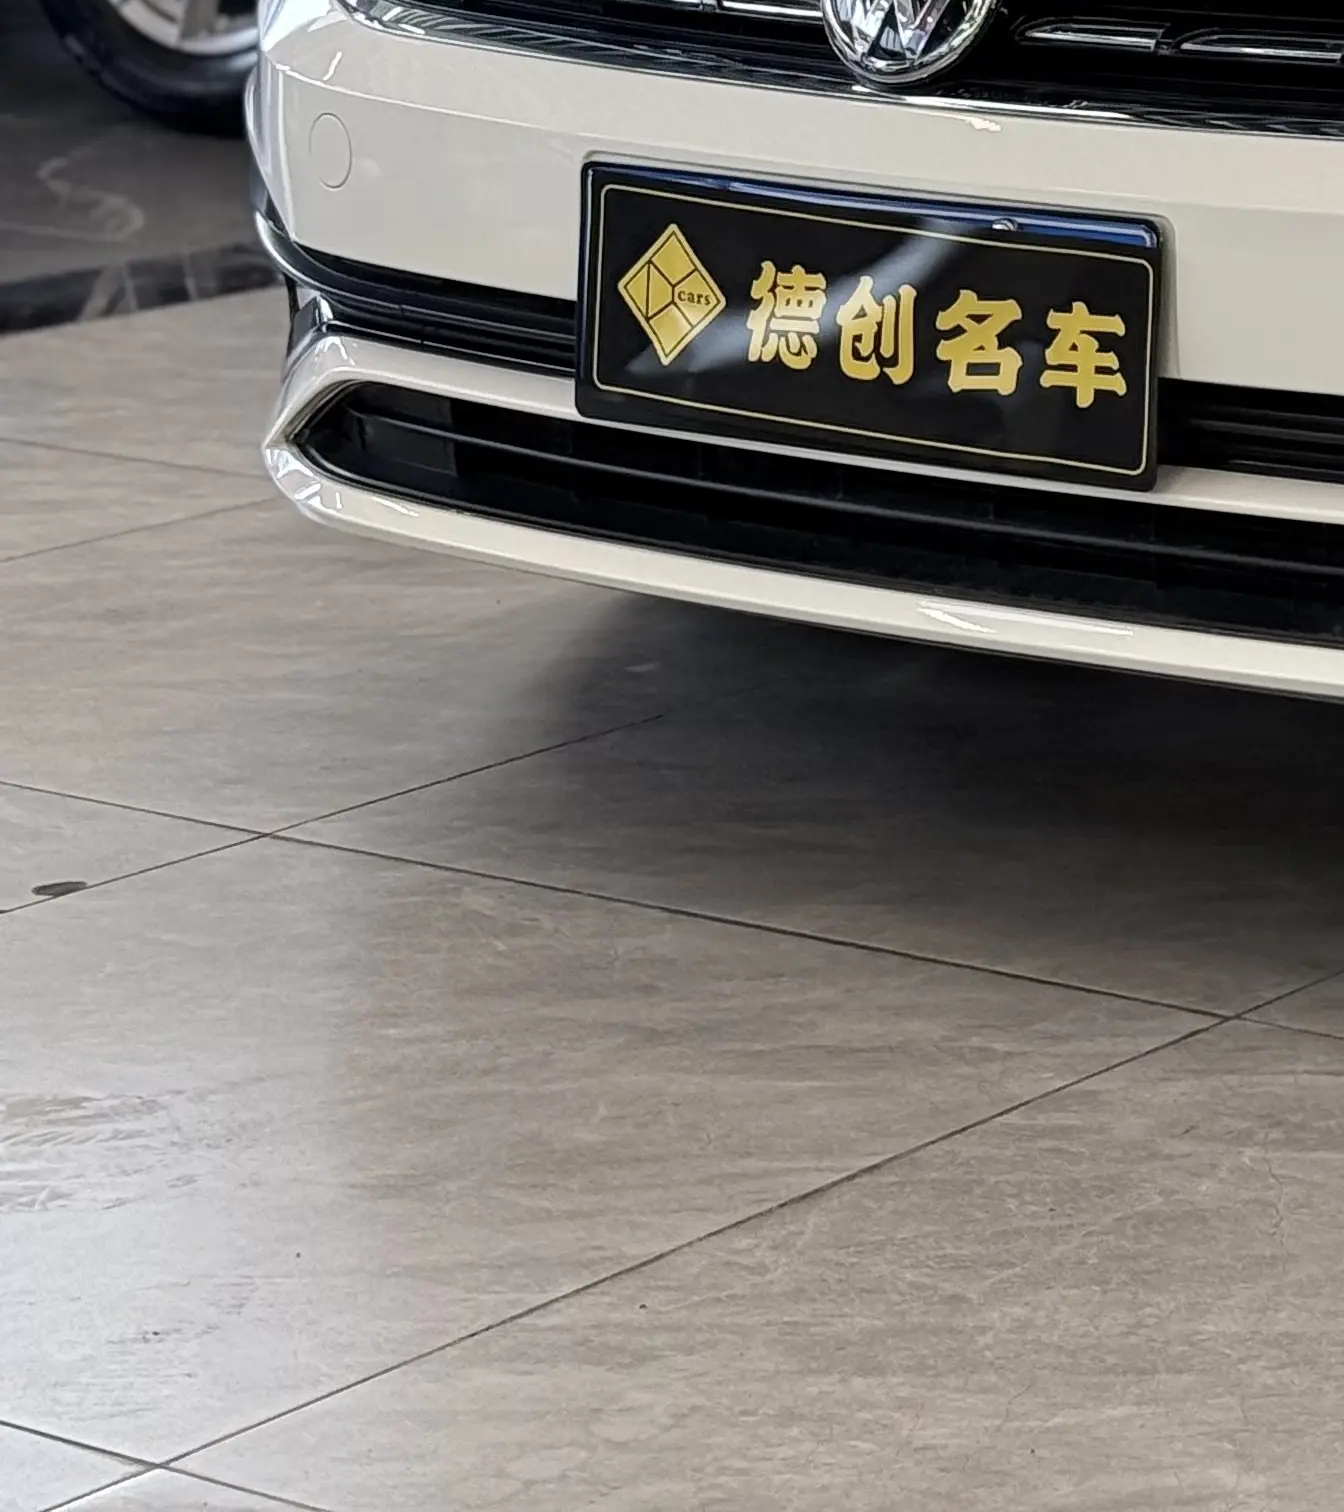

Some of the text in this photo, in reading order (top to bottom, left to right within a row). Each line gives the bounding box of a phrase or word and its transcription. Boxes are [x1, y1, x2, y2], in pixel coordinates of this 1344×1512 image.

[677, 290, 711, 306] cars
[746, 261, 1127, 408] 德创名车
